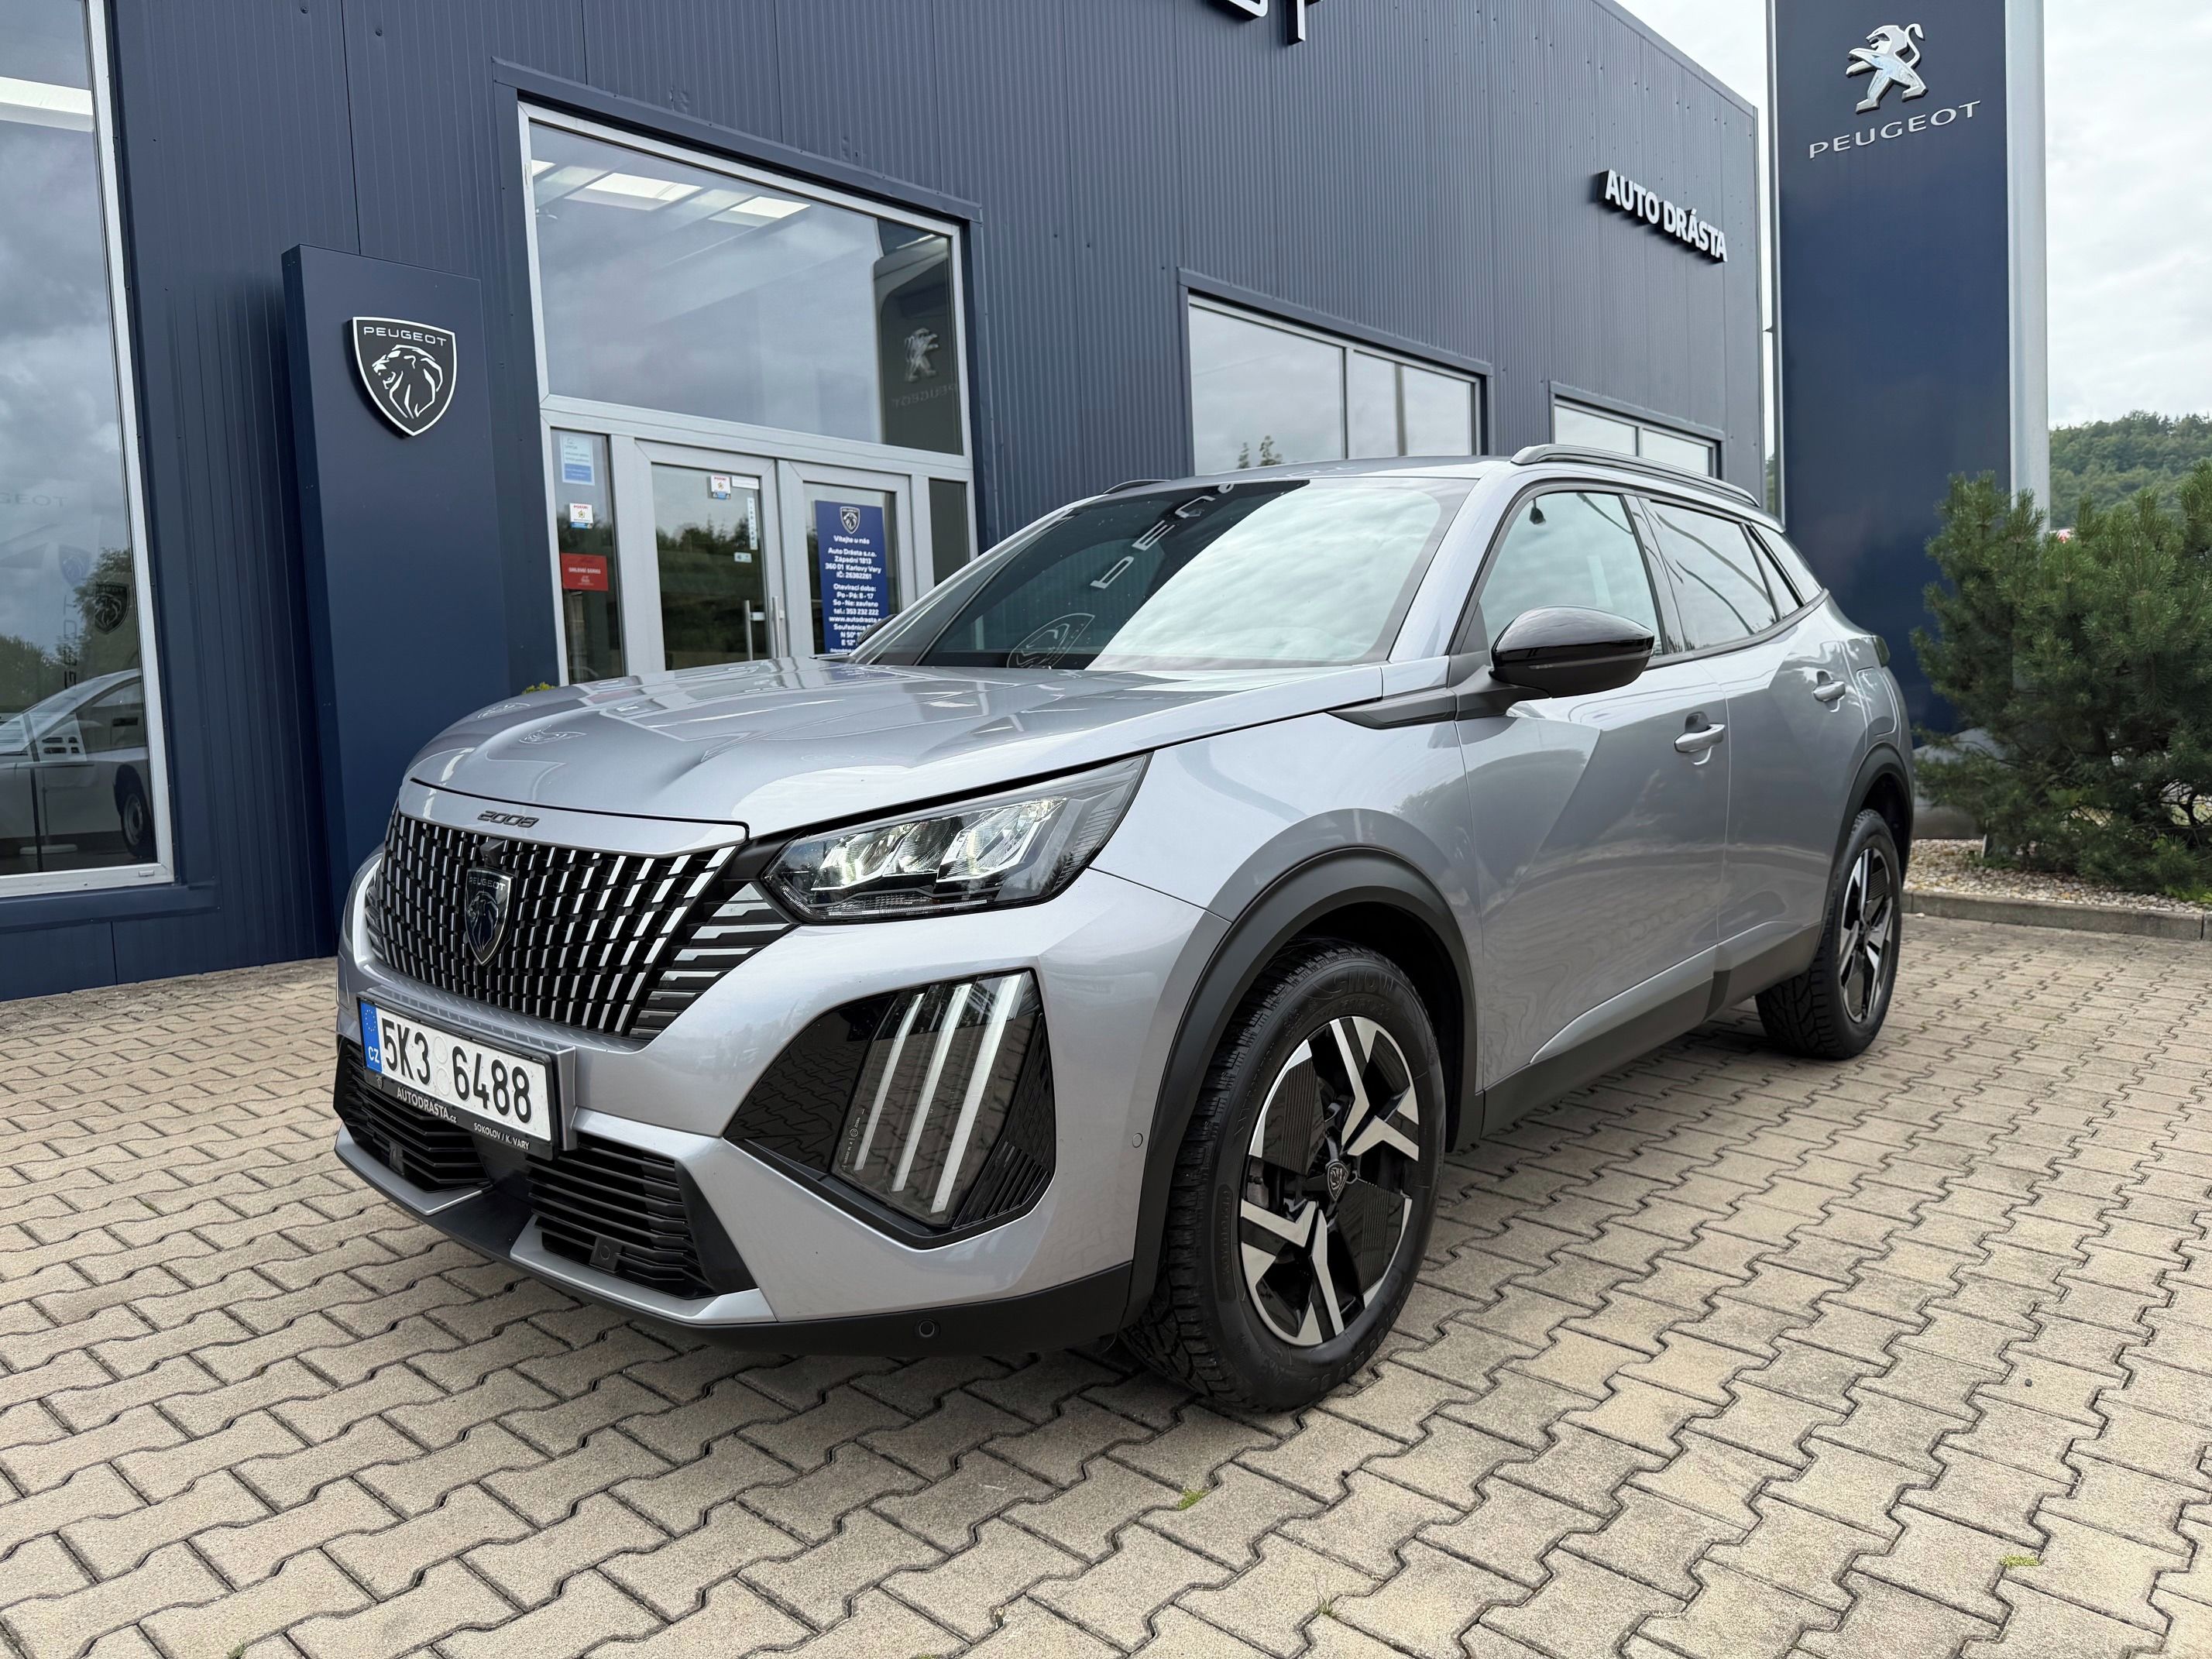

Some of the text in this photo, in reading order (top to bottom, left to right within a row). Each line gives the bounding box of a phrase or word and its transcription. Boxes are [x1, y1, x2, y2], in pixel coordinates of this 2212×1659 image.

[1808, 100, 1981, 160] PEUGEOT
[1605, 169, 1728, 263] AUTO DRÁSTA
[363, 326, 447, 346] PEUGEOT
[845, 564, 867, 573] Karlovy
[477, 810, 540, 829] 2008
[468, 876, 507, 891] PEUGEOT
[368, 1046, 380, 1064] CZ
[381, 1017, 533, 1124] 5K3 6488
[474, 1122, 502, 1141] SOKOLOV
[505, 1134, 513, 1145] K.
[512, 1136, 530, 1151] VARY
